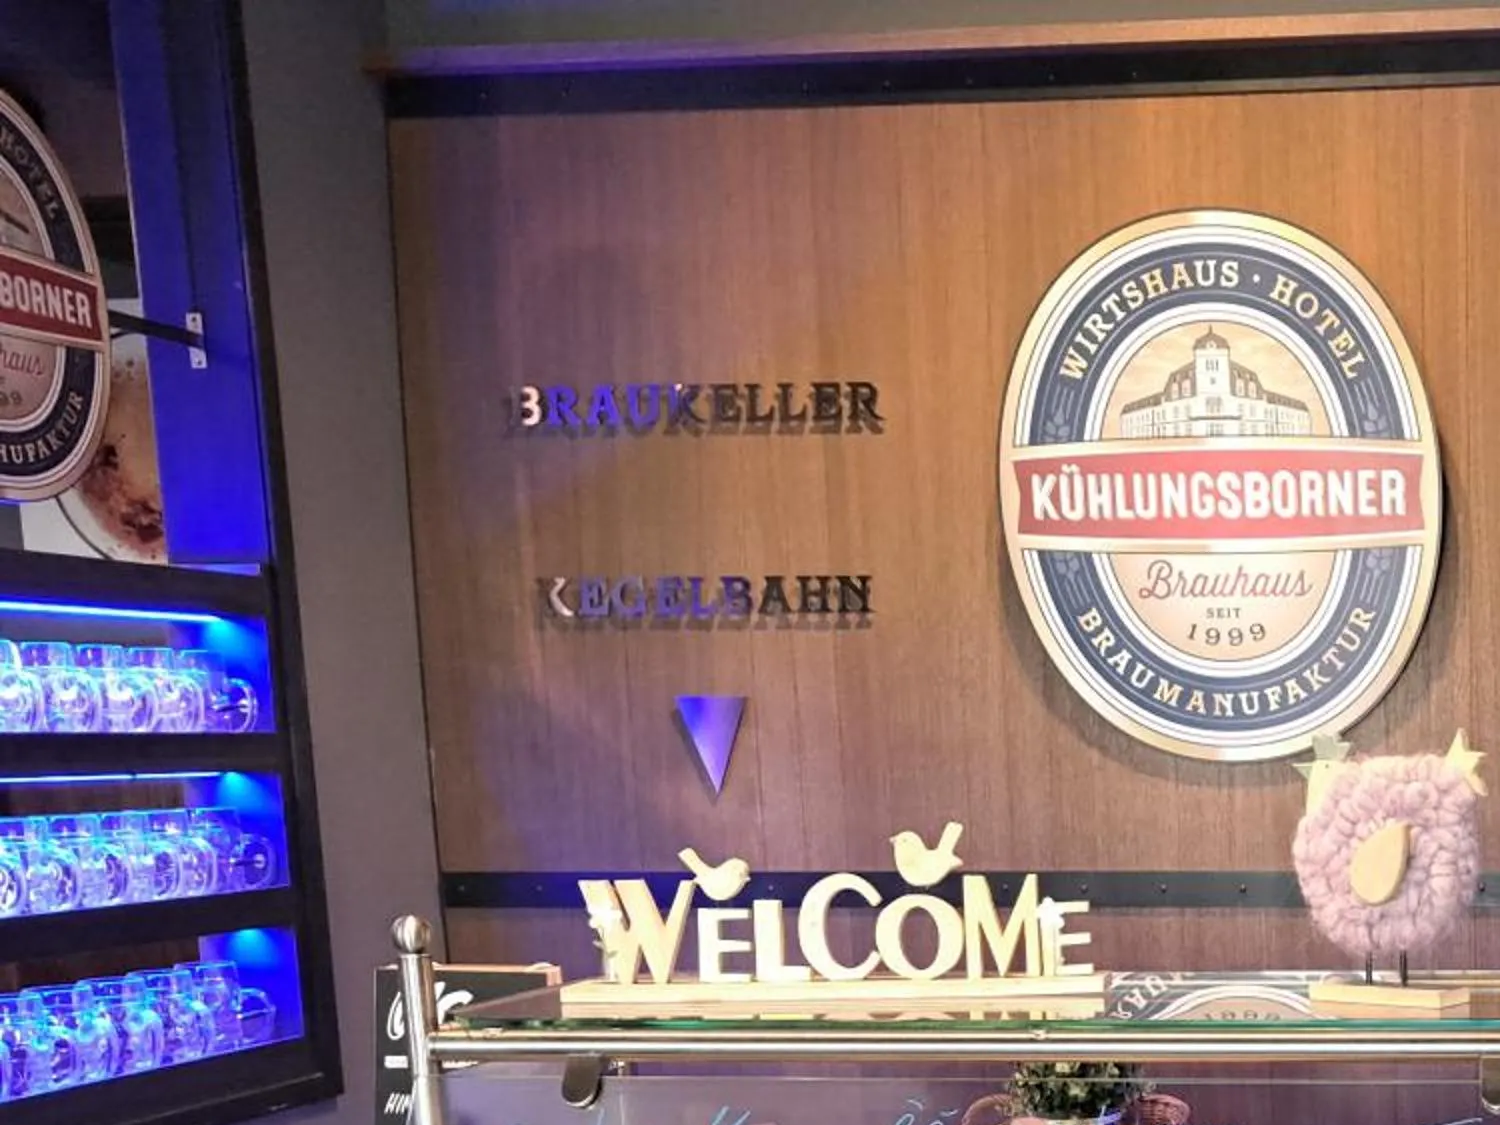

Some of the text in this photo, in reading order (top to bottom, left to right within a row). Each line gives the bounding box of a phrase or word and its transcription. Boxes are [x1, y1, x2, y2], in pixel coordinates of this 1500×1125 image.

[1059, 260, 1369, 381] WIRTSHAUS HOTEL
[510, 382, 886, 428] BRAUKELLER
[1031, 463, 1407, 521] KÜHLUNGSBORNER
[537, 575, 874, 618] KEGELBAHN
[1138, 560, 1314, 600] Brauhaus
[1186, 622, 1267, 647] 1999
[1205, 606, 1242, 620] SEIT
[1077, 605, 1376, 718] BRAUMANUFAKTUR
